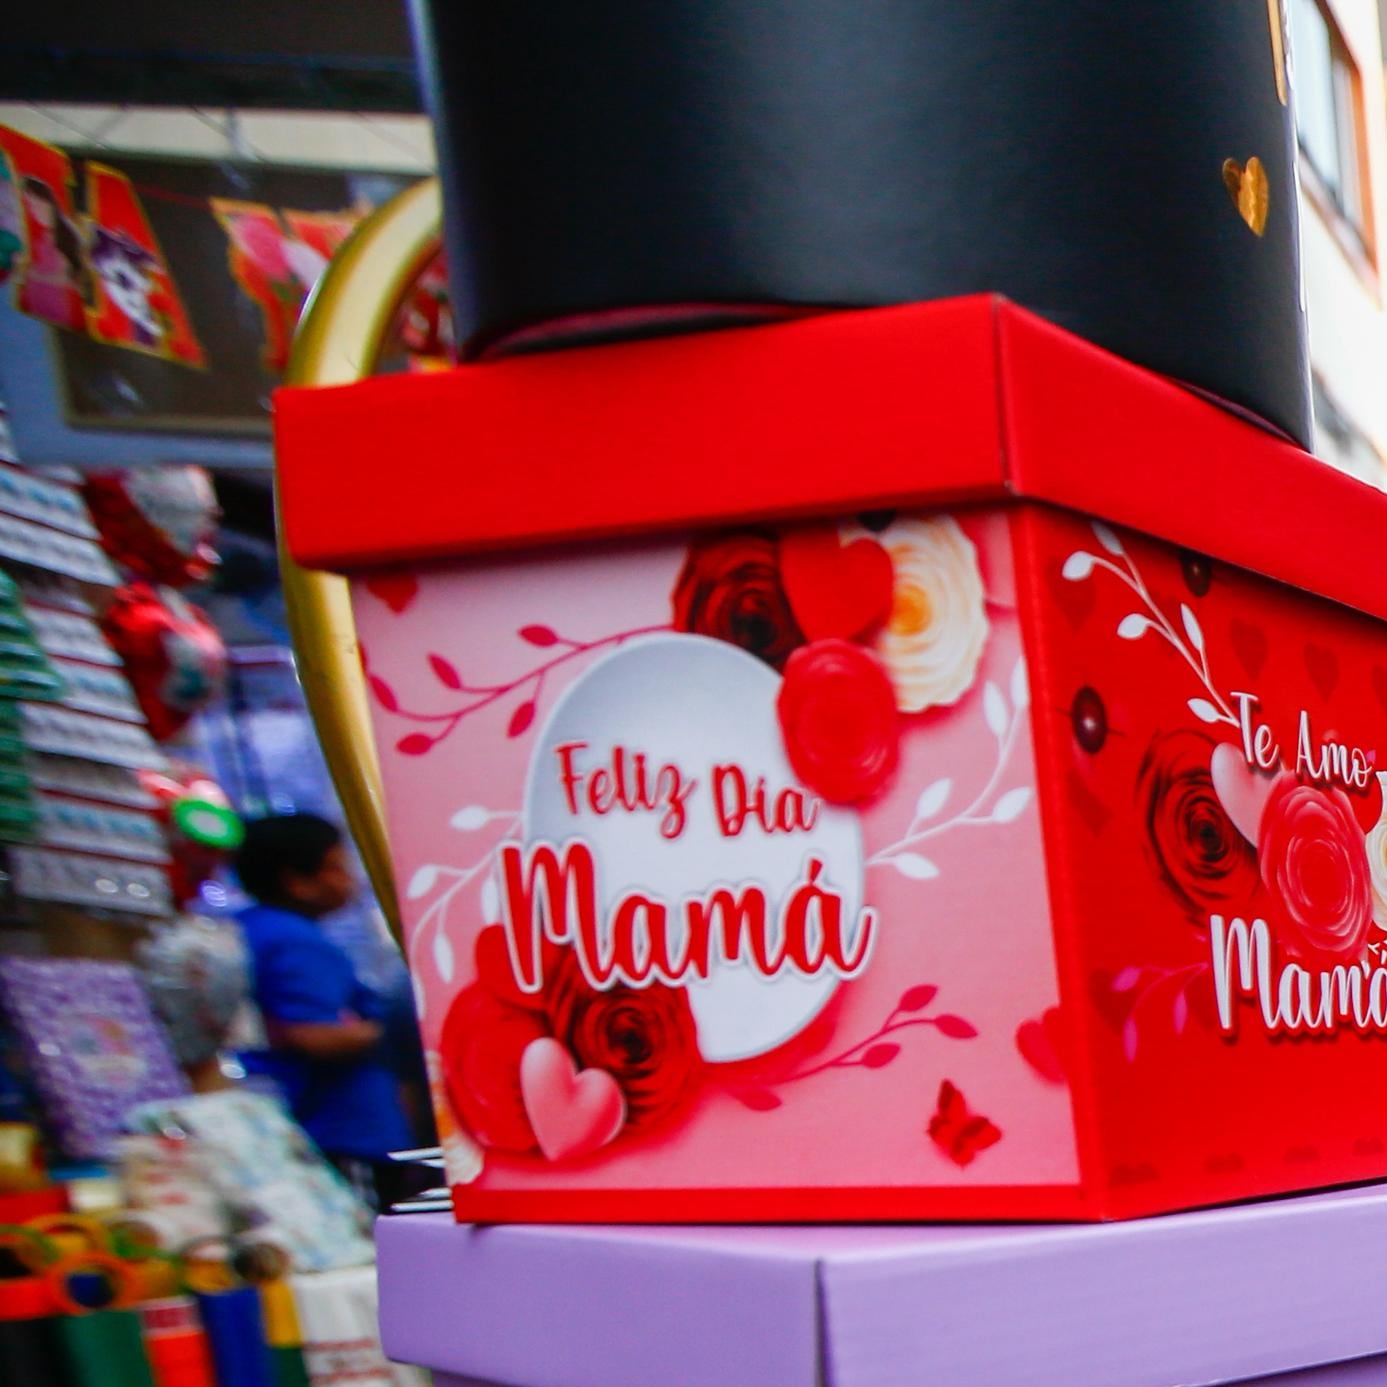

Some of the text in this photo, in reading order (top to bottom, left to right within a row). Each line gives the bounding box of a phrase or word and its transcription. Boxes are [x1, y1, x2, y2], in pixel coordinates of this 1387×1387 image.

[1230, 691, 1372, 787] Te Amo
[555, 741, 822, 840] Feliz Día
[502, 842, 873, 988] Mamá
